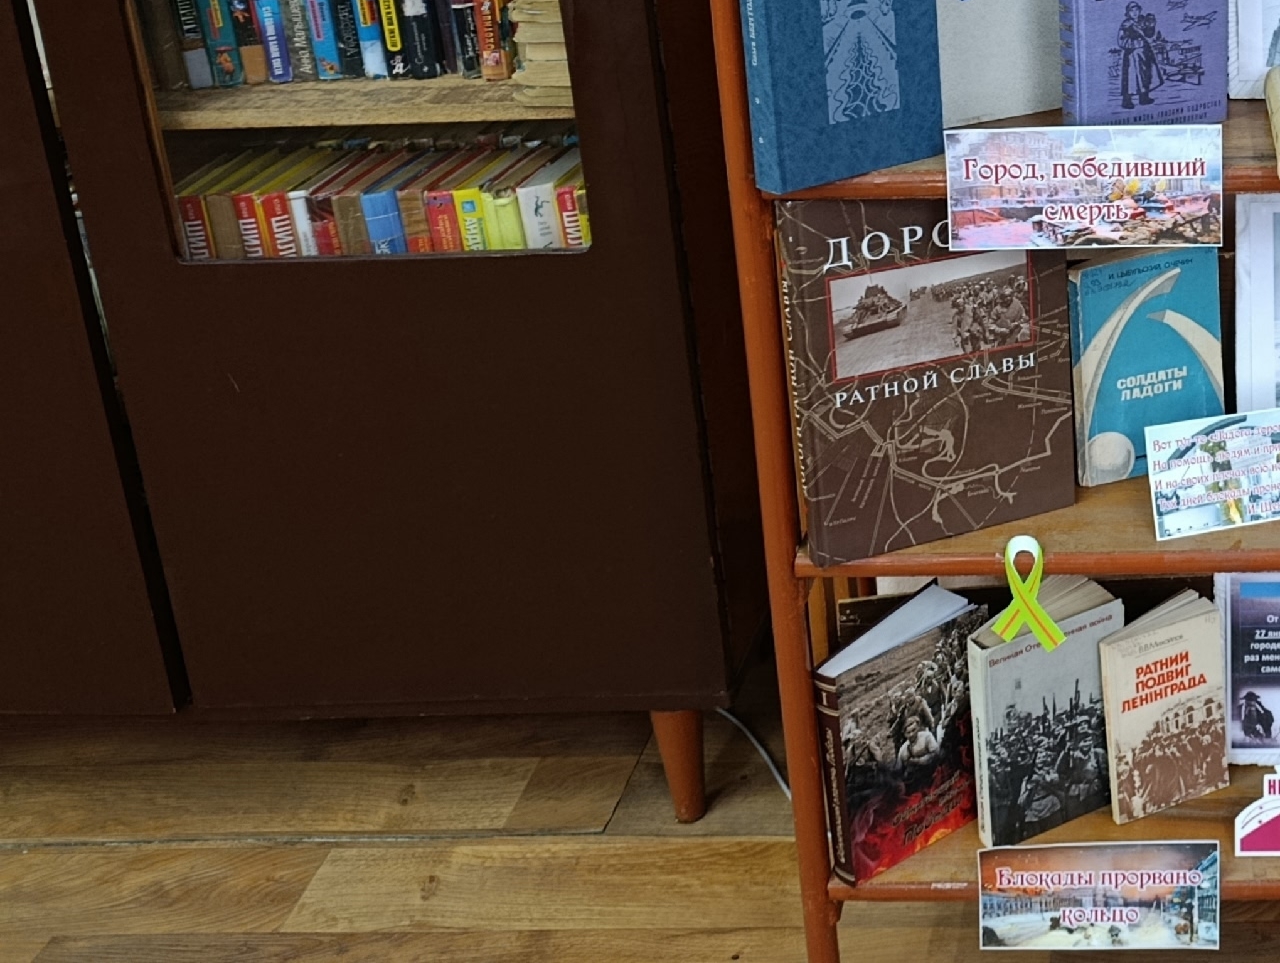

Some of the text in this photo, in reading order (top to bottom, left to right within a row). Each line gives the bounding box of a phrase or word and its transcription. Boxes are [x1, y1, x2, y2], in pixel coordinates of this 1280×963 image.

[963, 156, 1206, 184] Город, победивший
[1044, 202, 1131, 225] смерть
[834, 351, 1036, 409] РАТНОЙ СЛАВЫ
[1116, 365, 1188, 390] СОЛДАТЫ
[1120, 380, 1183, 402] ЛАДОГИ
[1135, 664, 1192, 695] ПОДВИГ
[1121, 673, 1208, 714] ЛЕНІНГРАДА
[995, 867, 1202, 891] Блокады прорвано
[1059, 908, 1140, 927] кольцо
